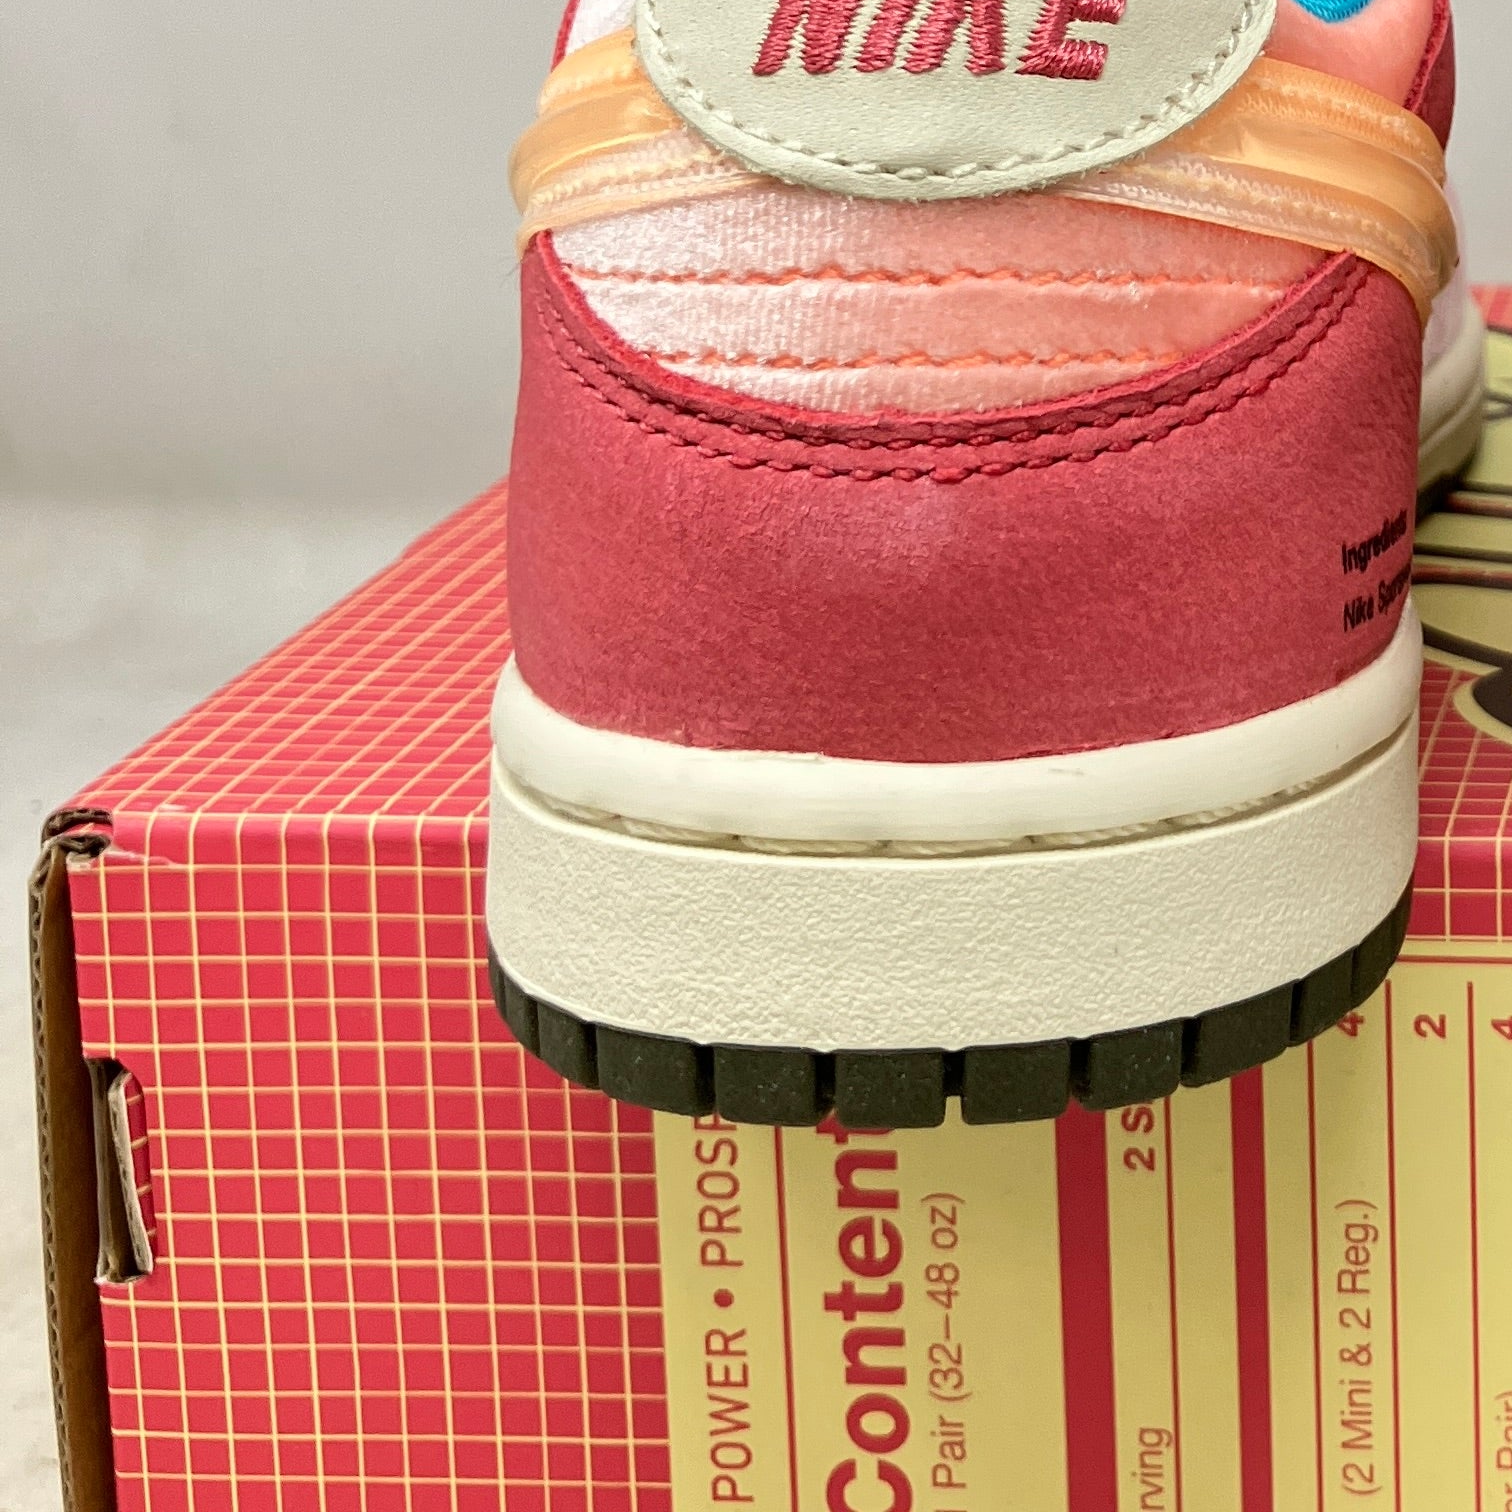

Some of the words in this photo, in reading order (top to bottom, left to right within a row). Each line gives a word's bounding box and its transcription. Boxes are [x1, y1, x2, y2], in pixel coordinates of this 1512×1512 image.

[1343, 593, 1375, 633] Nike
[1413, 1013, 1446, 1039] 2
[1121, 1100, 1156, 1133] S
[1124, 1148, 1156, 1171] 2
[921, 1193, 966, 1250] oz)
[1335, 1199, 1378, 1295] Reg.)
[1339, 1307, 1371, 1329] 2
[1339, 1343, 1371, 1366] &
[704, 1328, 754, 1503] POWER
[1339, 1379, 1374, 1451] Mini
[930, 1416, 967, 1489] Pair
[1342, 1463, 1382, 1496] (2
